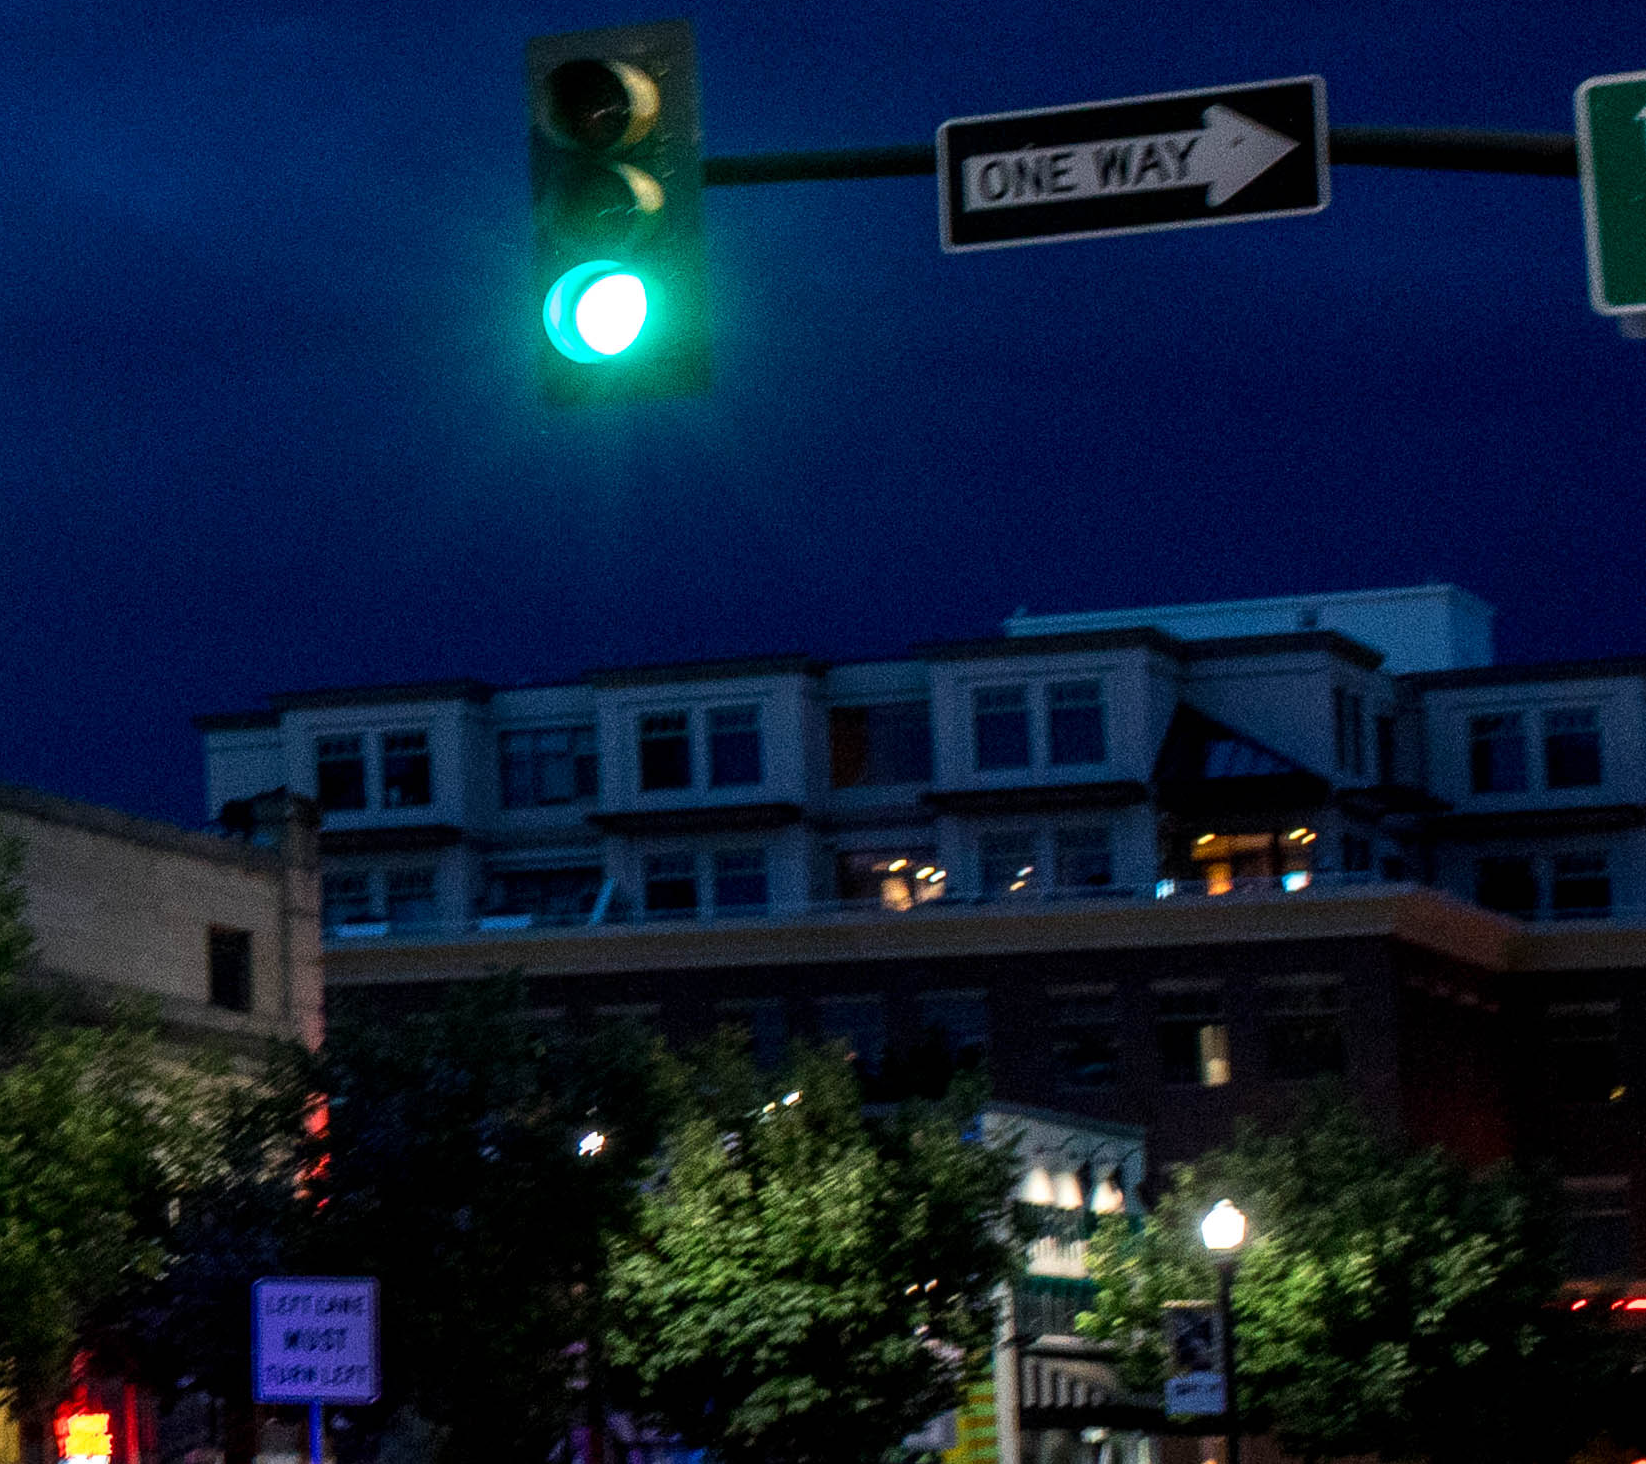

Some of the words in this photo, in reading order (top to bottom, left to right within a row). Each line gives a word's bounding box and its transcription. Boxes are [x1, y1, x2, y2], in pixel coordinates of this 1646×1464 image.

[980, 148, 1081, 203] ONE
[1096, 138, 1195, 190] WAY
[266, 1295, 314, 1316] LEFT
[315, 1295, 368, 1317] LANE
[283, 1326, 348, 1352] MUST
[265, 1364, 319, 1386] TURN
[321, 1364, 370, 1386] LEFT
